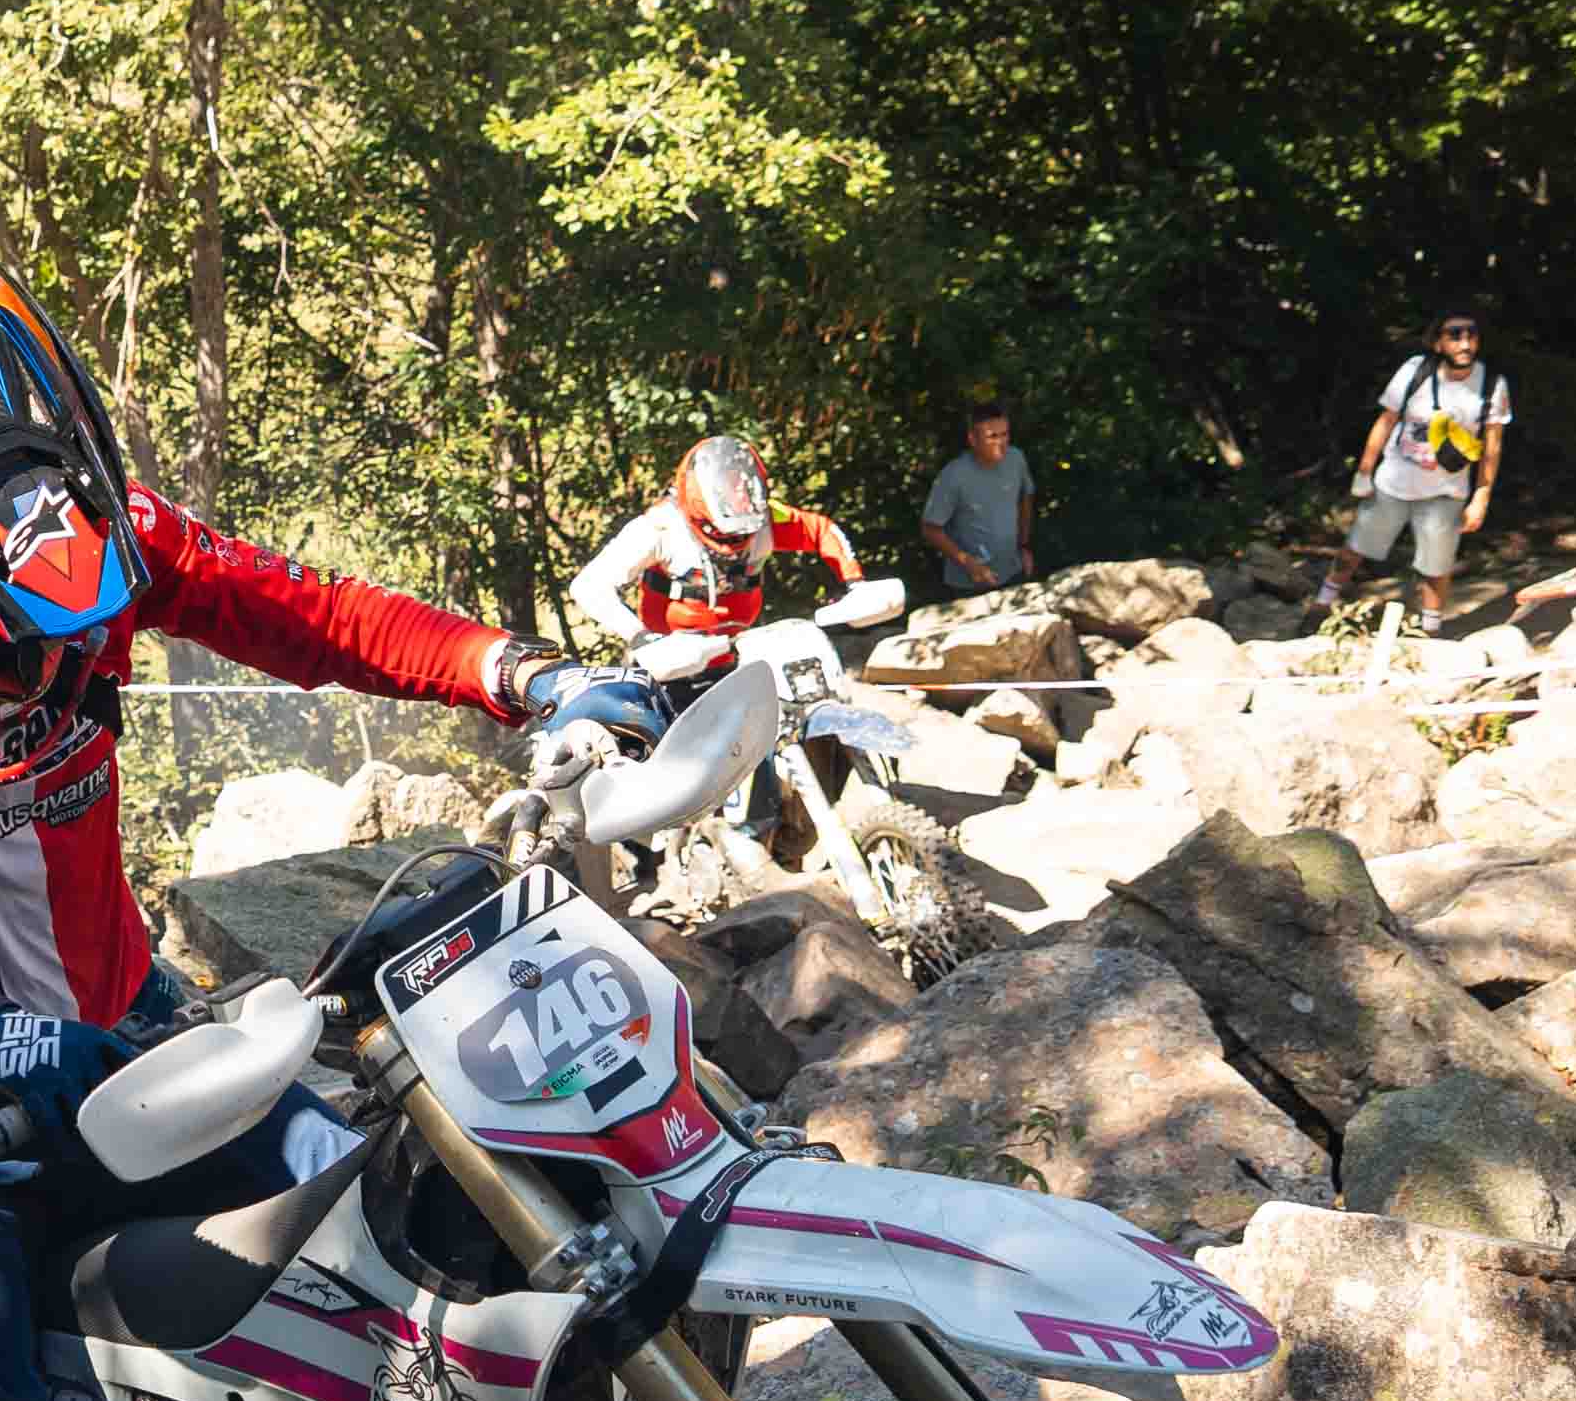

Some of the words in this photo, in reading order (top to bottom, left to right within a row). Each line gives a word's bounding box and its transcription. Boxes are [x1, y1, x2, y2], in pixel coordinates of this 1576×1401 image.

[488, 958, 631, 1088] 146
[724, 1289, 778, 1304] STARK
[785, 1293, 859, 1312] FUTURE
